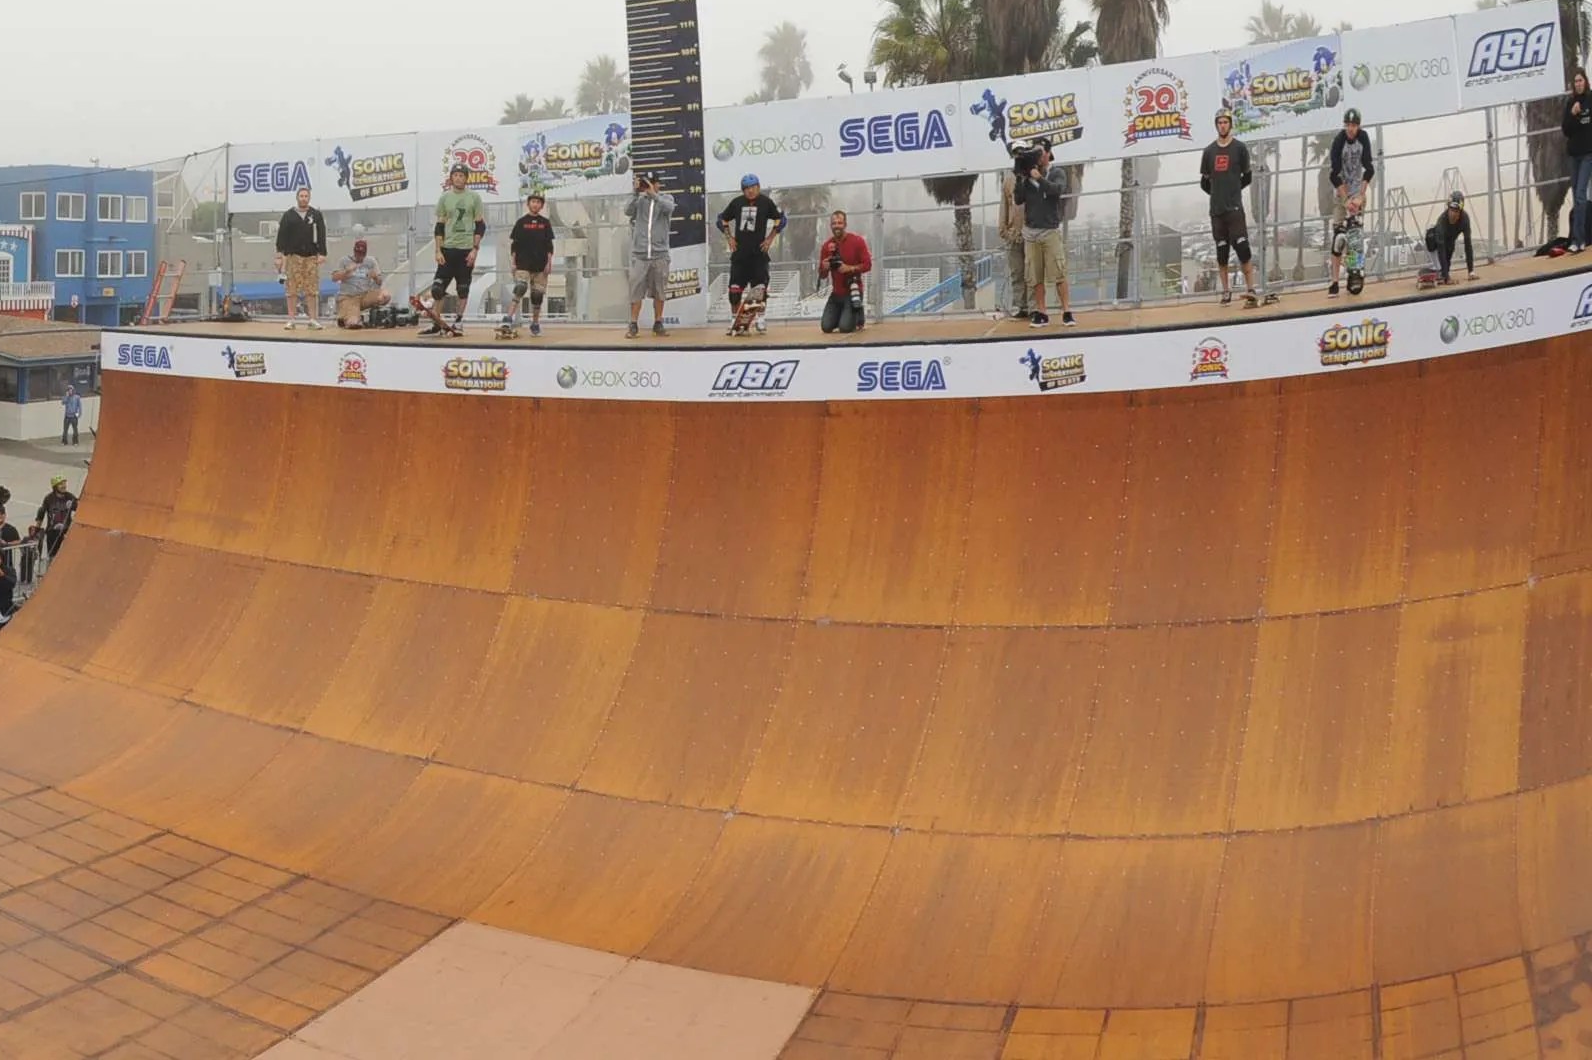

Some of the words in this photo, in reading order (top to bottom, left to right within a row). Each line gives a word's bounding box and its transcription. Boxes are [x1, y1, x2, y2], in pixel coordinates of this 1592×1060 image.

[1468, 22, 1555, 78] ASA
[1374, 61, 1419, 84] XBOX
[1420, 56, 1450, 78] 360
[1464, 67, 1547, 88] entertainment
[1252, 70, 1313, 96] SONIC
[1008, 93, 1077, 127] SONIC
[1136, 84, 1178, 115] 20
[839, 109, 954, 158] SEGA
[1009, 115, 1079, 139] GENERATIONS
[1134, 112, 1180, 132] SONIC
[546, 142, 602, 160] SONIC
[739, 136, 788, 157] XBOX
[790, 132, 824, 151] 360
[233, 161, 312, 194] SEGA
[352, 153, 405, 177] SONIC
[668, 267, 699, 284] ONIC
[1464, 311, 1506, 336] XBOX
[1506, 307, 1535, 330] 360
[1321, 322, 1388, 352] SONIC
[118, 344, 171, 369] SEGA
[1041, 354, 1085, 373] SONIC
[1199, 348, 1222, 362] 20
[1321, 347, 1387, 366] GENERATIONS
[446, 360, 506, 379] SONIC
[581, 370, 627, 388] XBOX
[629, 371, 661, 388] 360
[712, 360, 800, 390] ASA
[857, 359, 947, 392] SEGA
[708, 390, 786, 399] entertainment
